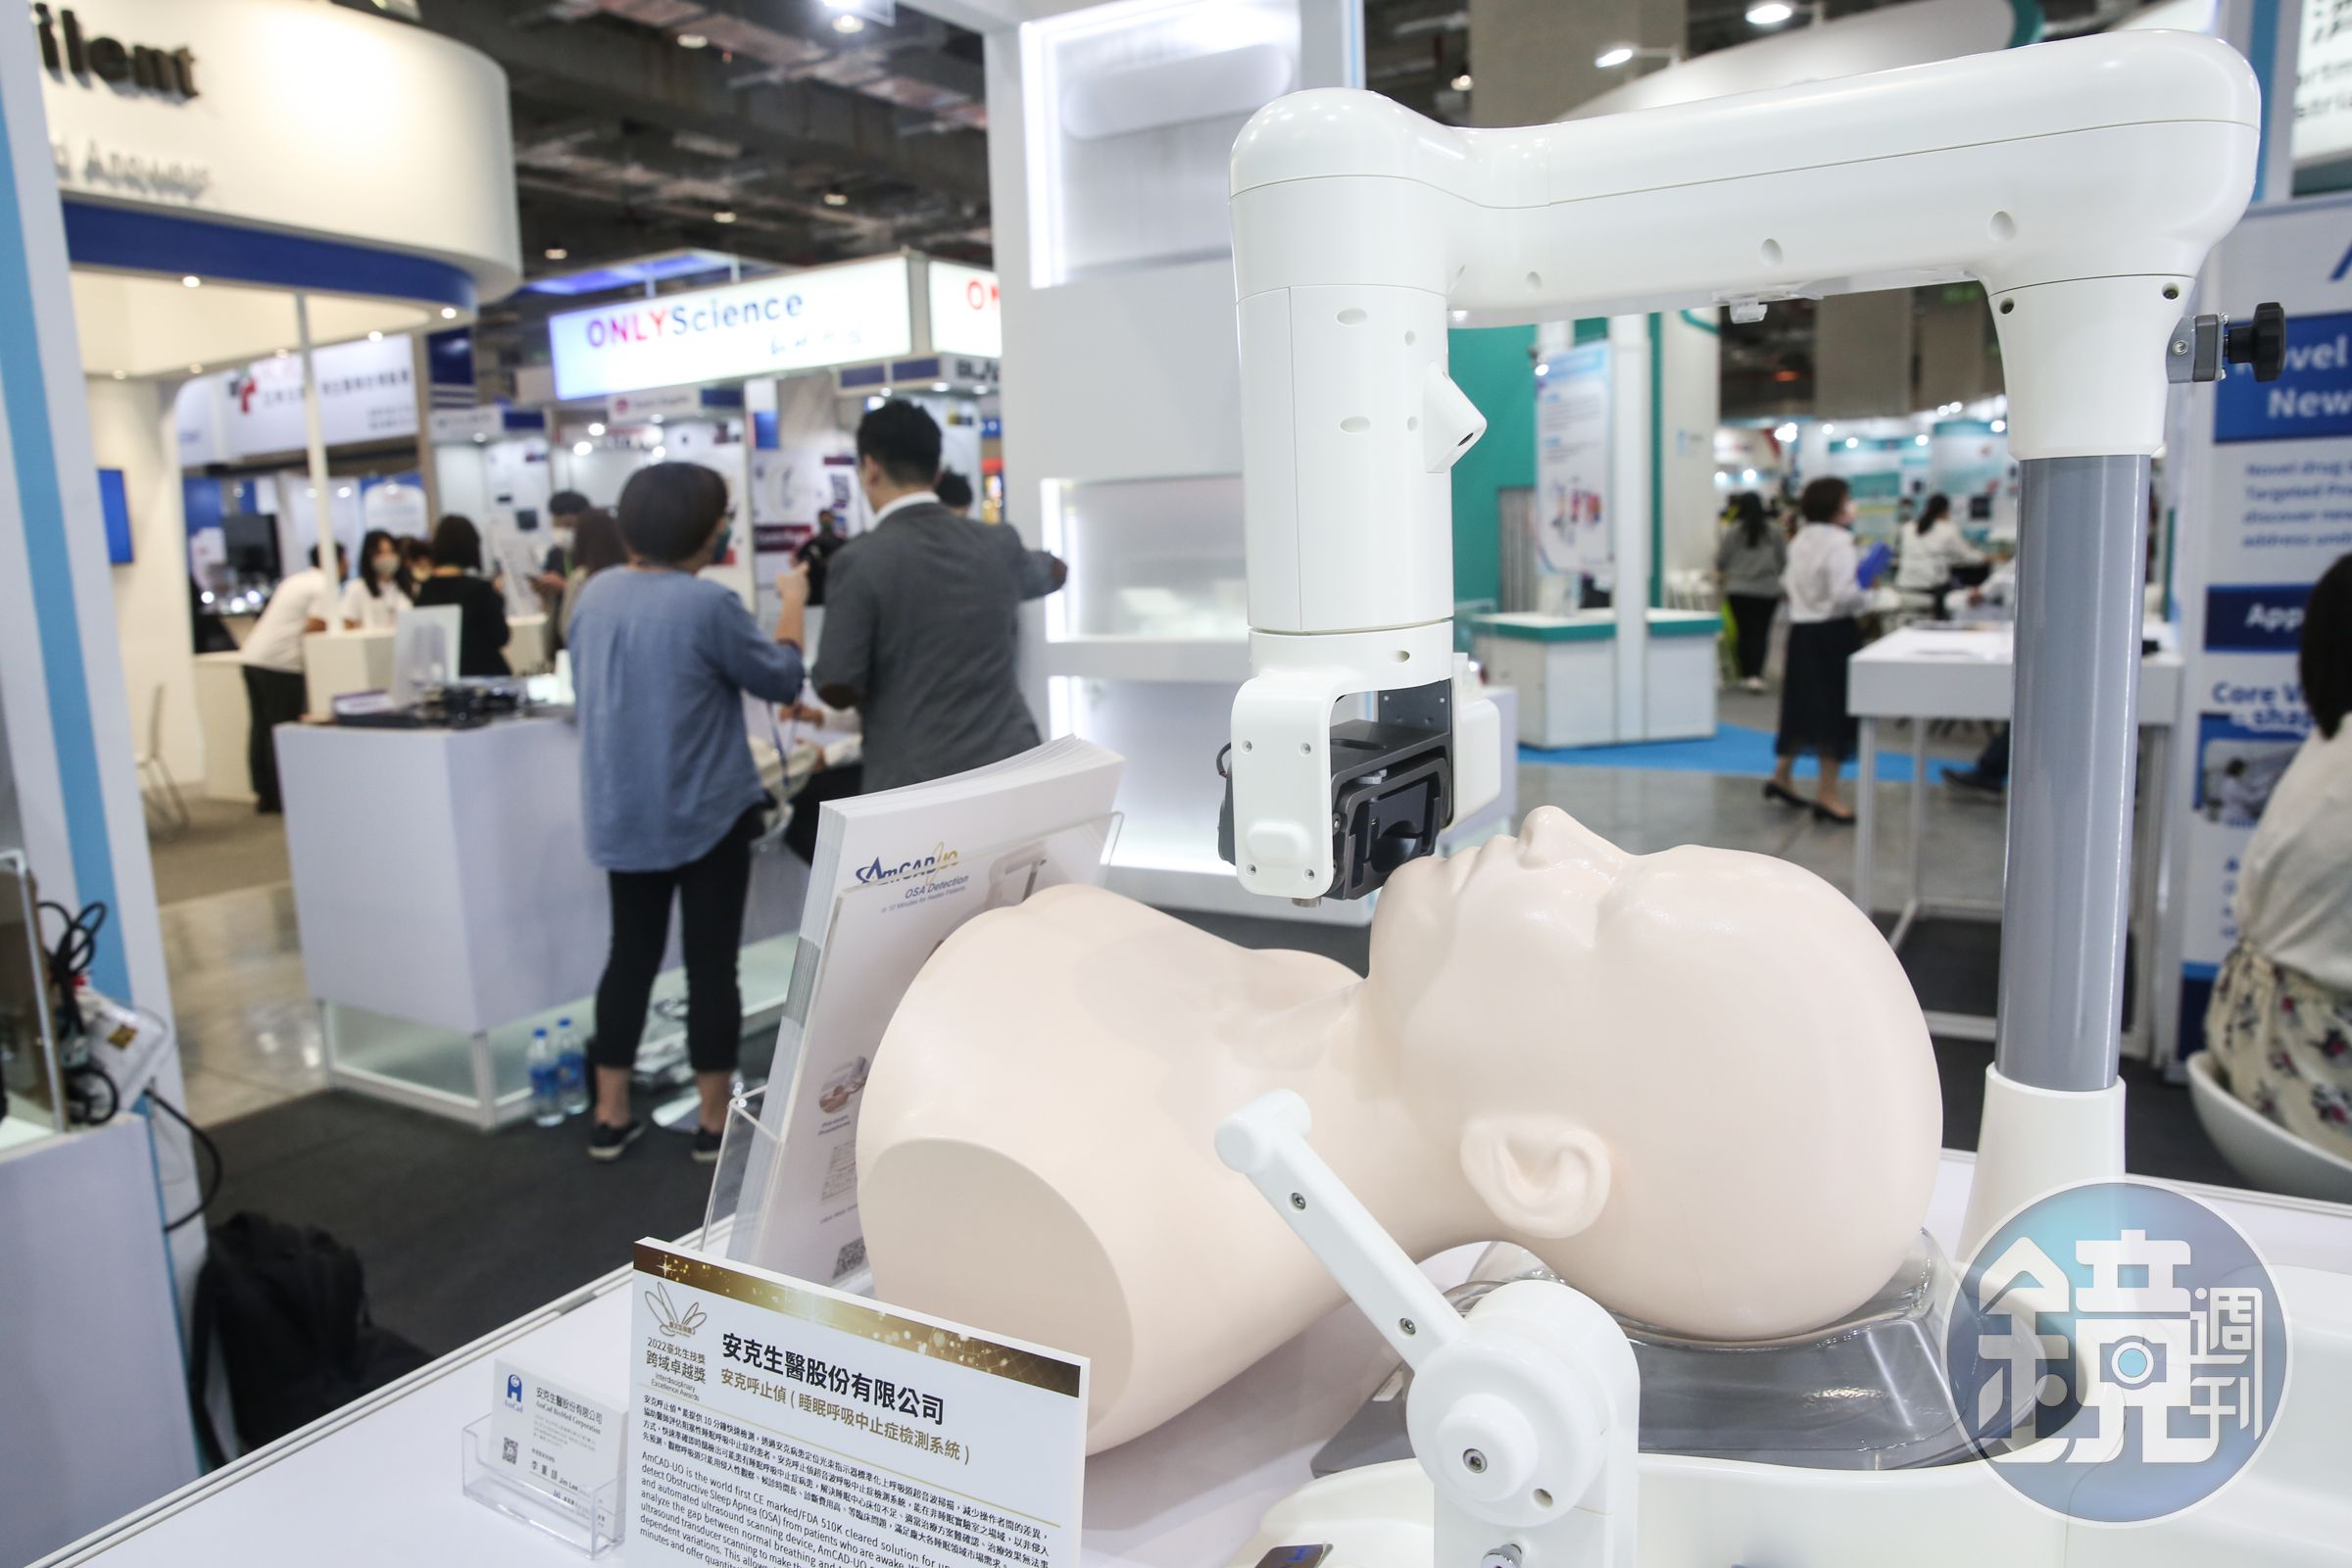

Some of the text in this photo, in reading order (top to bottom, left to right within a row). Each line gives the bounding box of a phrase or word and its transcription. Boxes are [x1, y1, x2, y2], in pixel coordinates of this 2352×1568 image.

[586, 291, 805, 349] ONLYScience
[905, 875, 969, 899] OSA Detection
[646, 1349, 707, 1385] 跨域卓越獎
[720, 1367, 787, 1404] 安克呼止偵
[722, 1332, 944, 1426] 安克生醫股份有限公司
[704, 1416, 712, 1427] 10
[640, 1514, 680, 1538] dependent
[682, 1533, 722, 1555] variations.
[725, 1547, 741, 1562] This
[641, 1450, 936, 1568] AmCAD-UO is the world first CE marked/FDA 510K cleared solution for
[641, 1463, 664, 1481] detect
[665, 1472, 710, 1497] Obstructive
[710, 1489, 732, 1507] Sleep
[732, 1498, 758, 1516] Apnea
[759, 1507, 781, 1527] (OSA)
[782, 1516, 803, 1533] from
[804, 1527, 838, 1546] patients
[839, 1541, 858, 1554] who
[859, 1547, 874, 1560] are
[641, 1477, 657, 1490] and
[658, 1484, 700, 1506] automated
[701, 1500, 745, 1524] ultrasound
[746, 1518, 784, 1542] scanning
[785, 1532, 815, 1553] device,
[641, 1490, 670, 1508] analyze
[672, 1501, 685, 1514] the
[687, 1508, 703, 1522] gap
[704, 1512, 739, 1536] between
[741, 1530, 772, 1548] normal
[774, 1540, 816, 1568] breathing
[641, 1502, 680, 1525] ultrasound
[681, 1518, 722, 1541] transducer
[722, 1536, 759, 1558] scanning
[759, 1548, 768, 1560] to
[640, 1528, 669, 1546] minutes
[670, 1541, 685, 1552] and
[685, 1546, 704, 1560] offer
